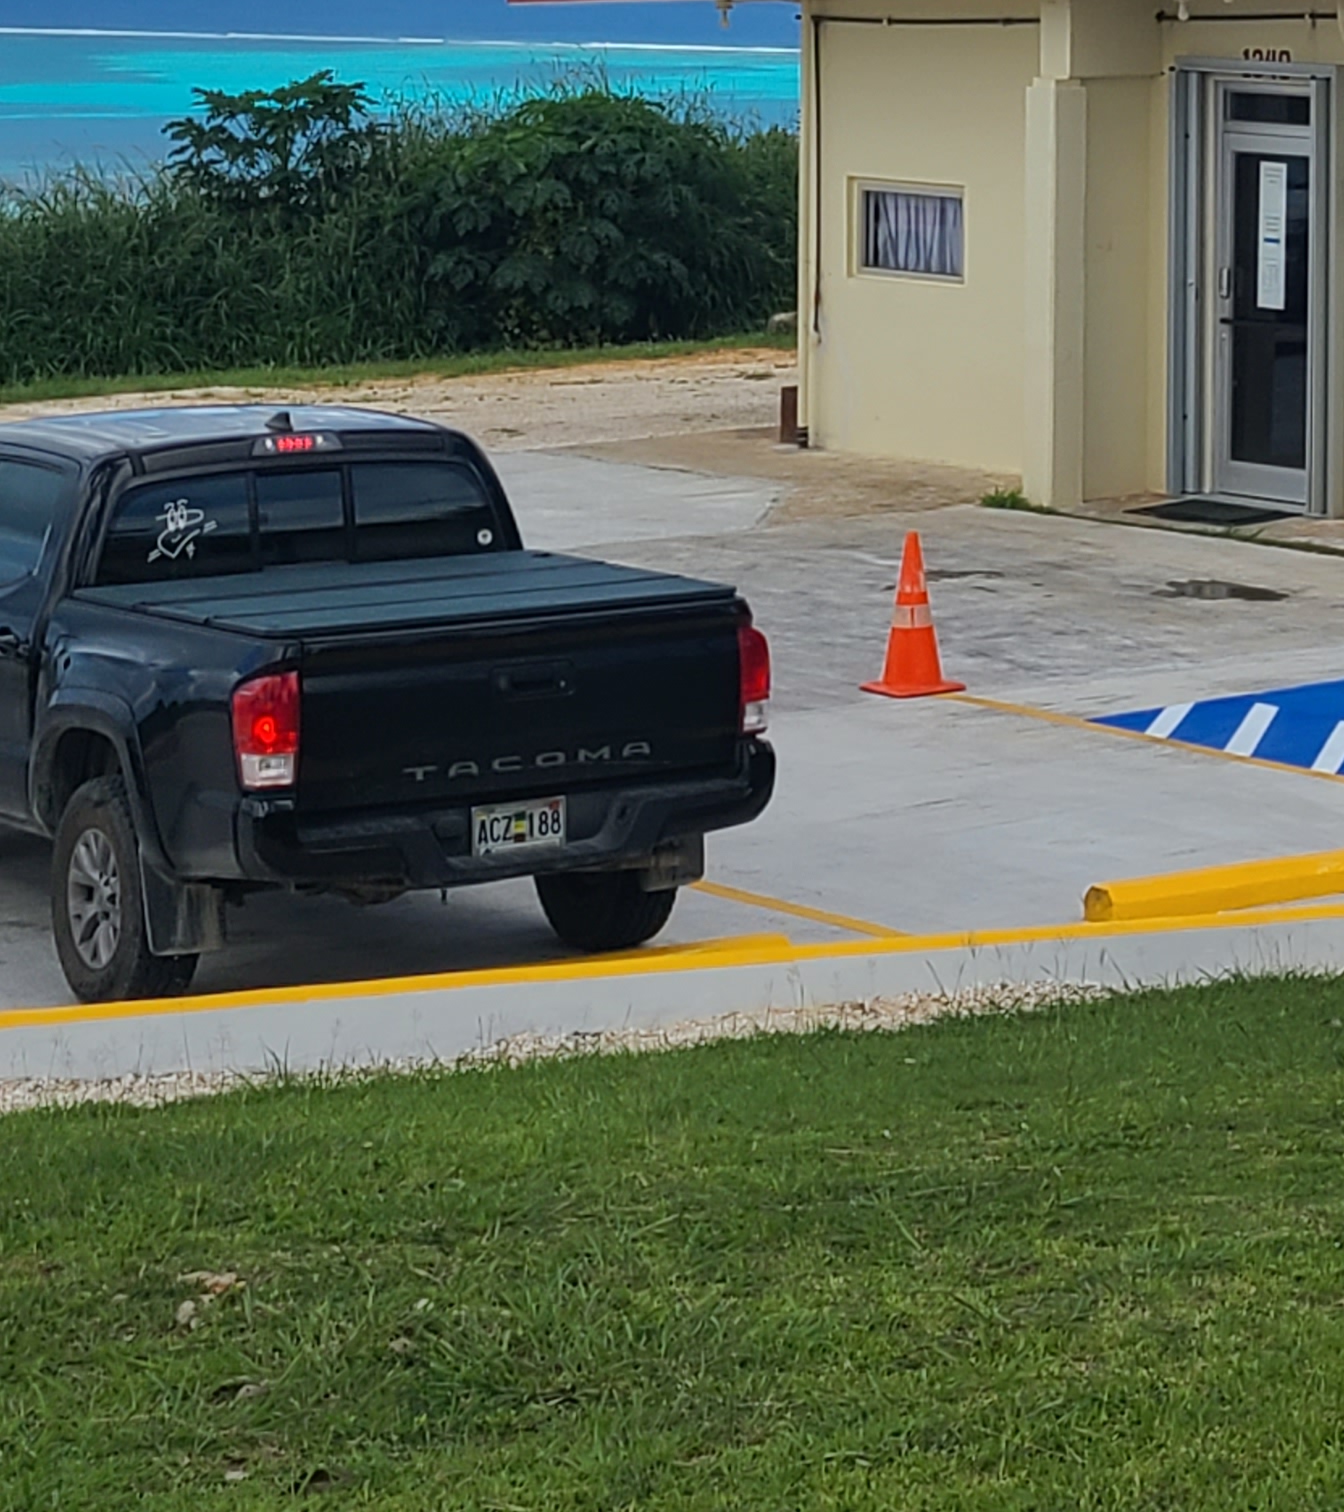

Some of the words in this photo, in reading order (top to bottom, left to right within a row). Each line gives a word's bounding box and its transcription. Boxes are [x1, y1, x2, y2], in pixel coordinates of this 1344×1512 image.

[402, 741, 652, 781] TACOMA
[478, 816, 513, 845] ACZ
[528, 809, 561, 838] 188
